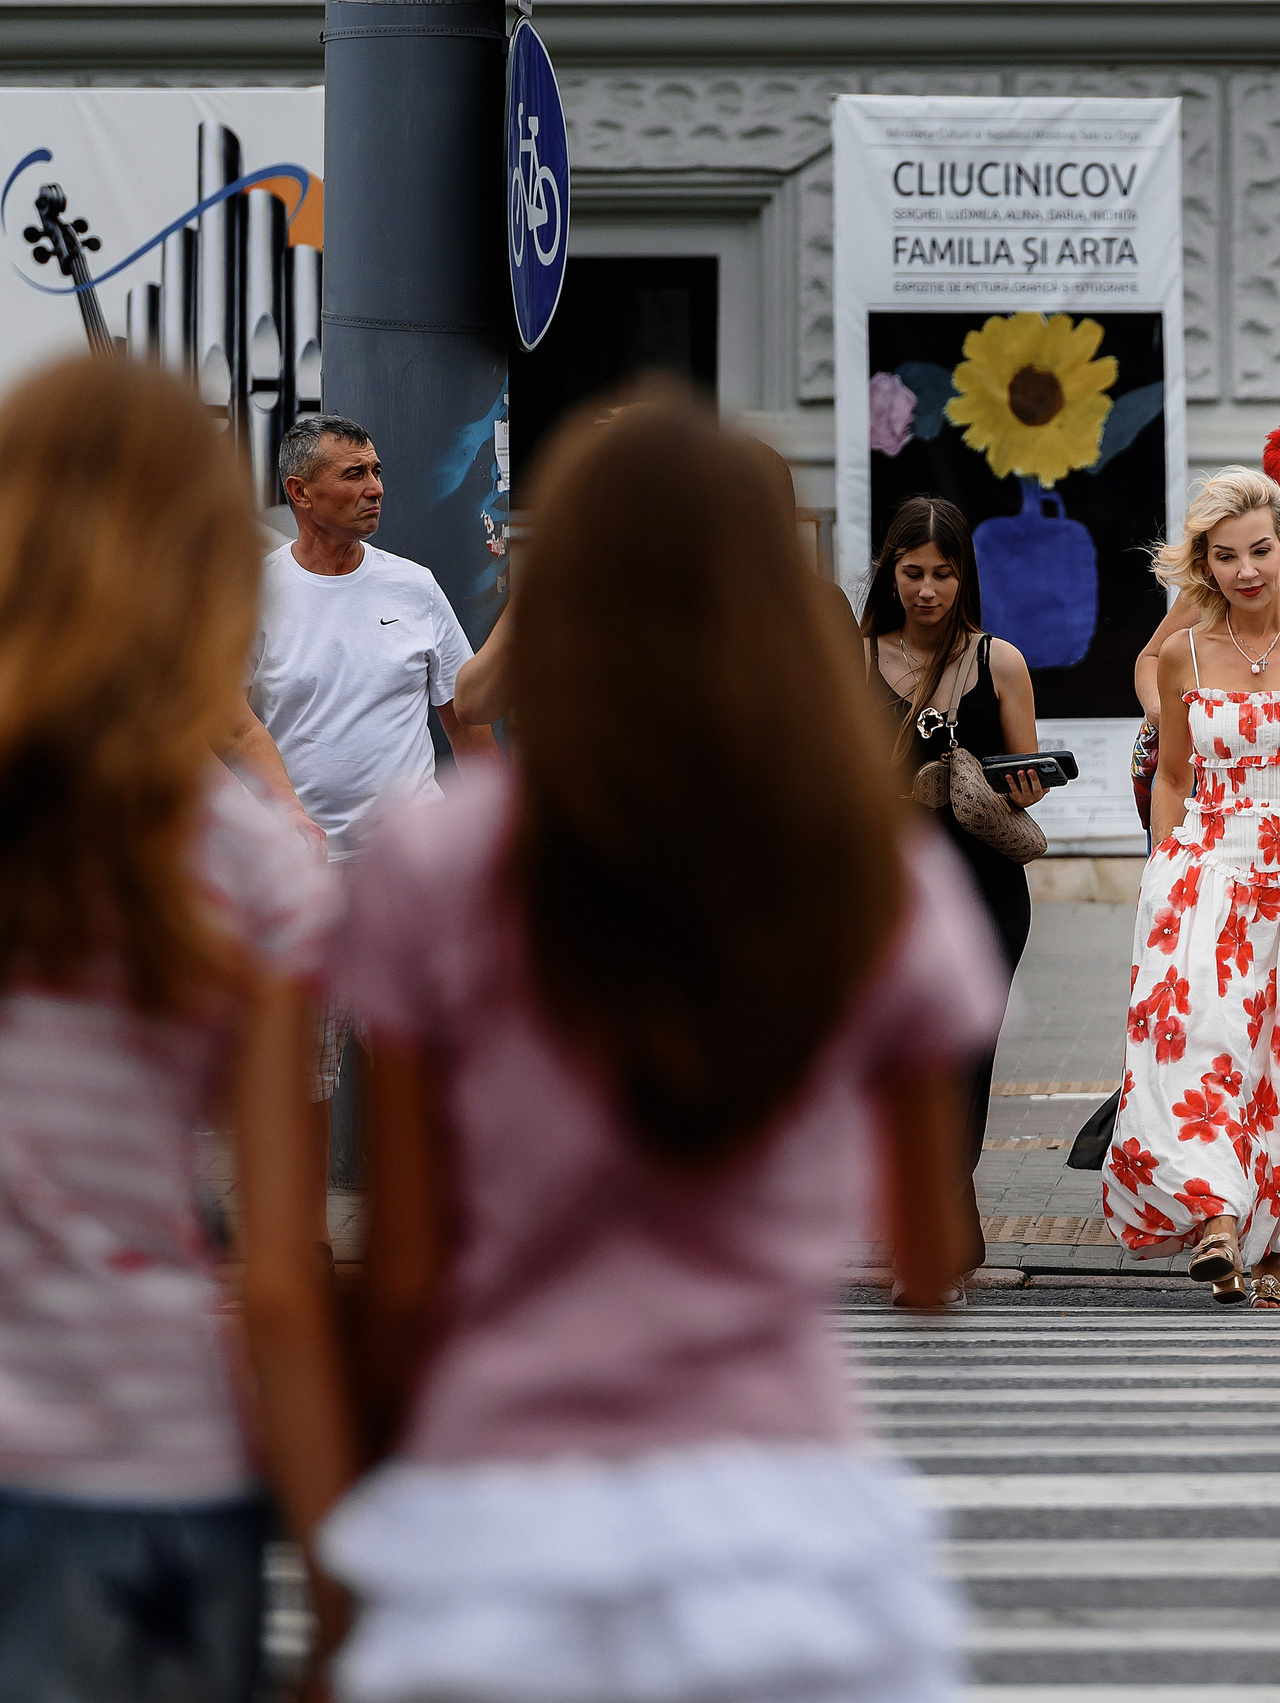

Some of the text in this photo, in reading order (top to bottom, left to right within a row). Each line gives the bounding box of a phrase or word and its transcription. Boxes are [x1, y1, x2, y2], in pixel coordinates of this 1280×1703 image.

[893, 160, 1138, 198] CLIUCINICOV
[893, 236, 1015, 266] FAMILIA
[1055, 237, 1138, 265] ARTA
